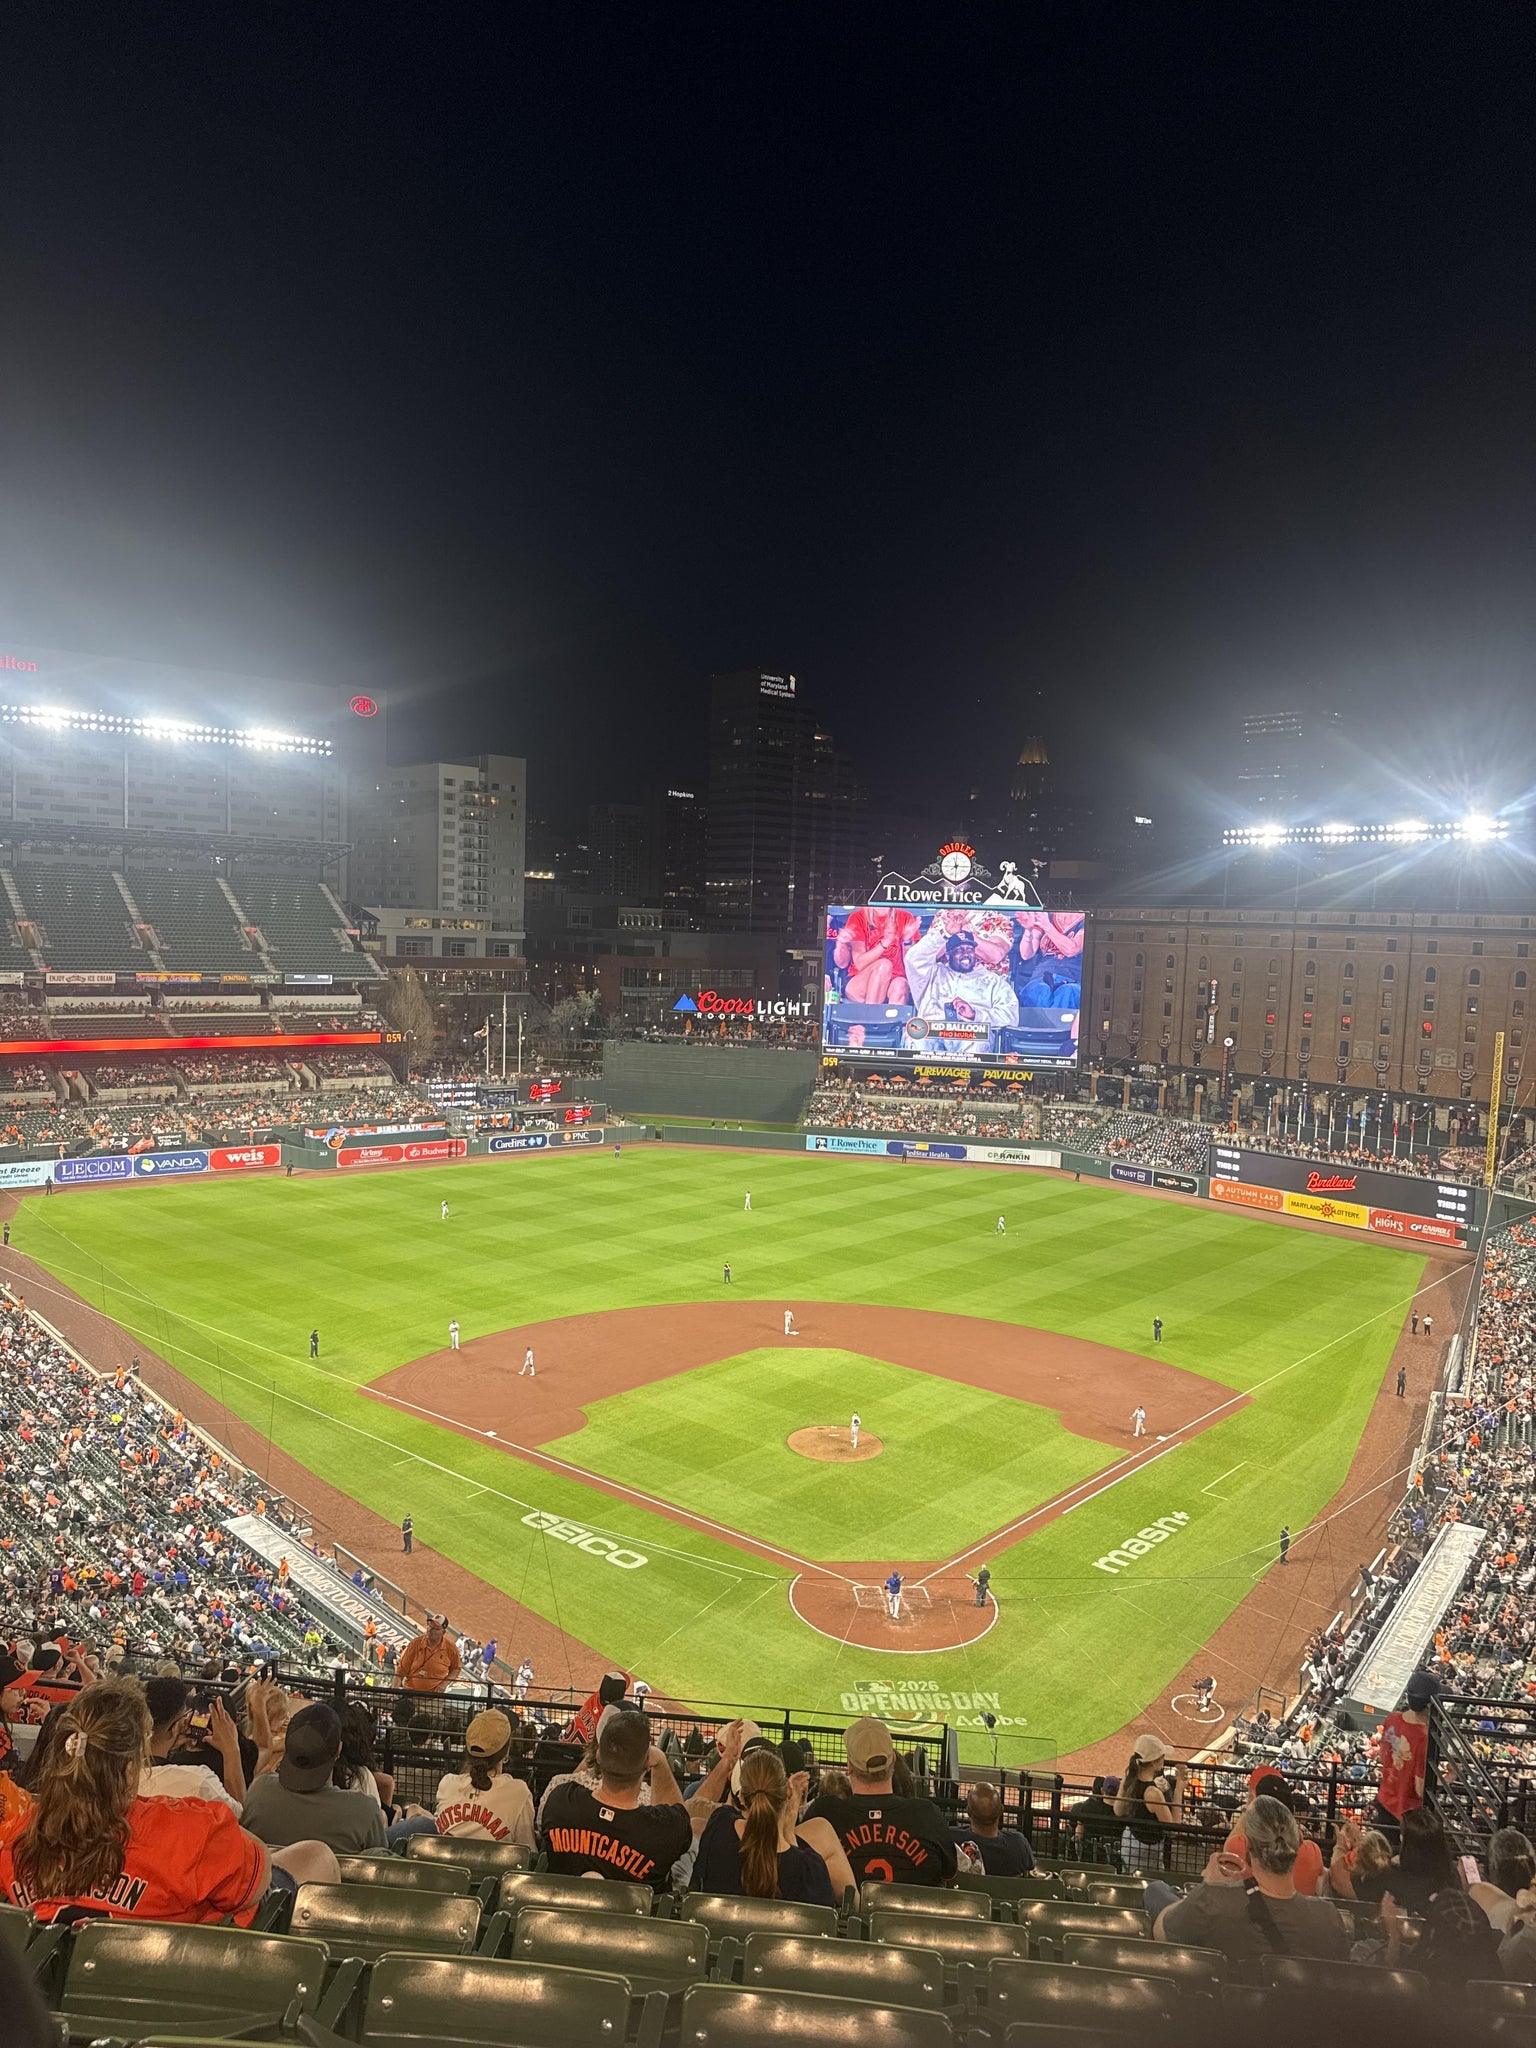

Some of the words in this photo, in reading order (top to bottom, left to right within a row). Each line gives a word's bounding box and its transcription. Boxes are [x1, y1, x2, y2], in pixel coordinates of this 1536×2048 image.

[760, 673, 784, 683] University
[767, 682, 788, 690] Maryland
[760, 688, 778, 696] Medical
[779, 690, 795, 698] System
[939, 842, 976, 858] ORIOLES
[698, 991, 754, 1013] Coors
[757, 1000, 812, 1016] LIGHT
[931, 1023, 945, 1031] KID
[946, 1024, 986, 1032] BALLOON
[914, 1067, 971, 1078] PUREWAGER
[983, 1070, 1034, 1081] PAVILION
[377, 1125, 398, 1134] BIRD
[399, 1123, 422, 1133] BATH
[572, 1132, 589, 1140] PNC
[495, 1137, 528, 1149] CareFirst
[226, 1149, 264, 1163] weis
[422, 1146, 462, 1155] Budweser
[905, 1150, 929, 1158] edStar
[61, 1160, 126, 1176] LECOM
[155, 1157, 202, 1168] VANDA
[1116, 1168, 1137, 1178] TRUIST
[1306, 1171, 1358, 1193] Birdland
[1226, 1186, 1258, 1198] AUTUMN
[1259, 1192, 1279, 1202] LAKE
[1291, 1201, 1320, 1212] MARYLAND
[1375, 1217, 1404, 1232] HIGH'S
[1422, 1224, 1451, 1235] CARROLL
[520, 1511, 648, 1570] GEICO
[1091, 1511, 1191, 1574] masn+
[897, 1680, 939, 1692] 2026
[840, 1692, 952, 1712] OPENING
[951, 1692, 1000, 1710] DAY
[843, 1823, 928, 1867] NDERSON
[549, 1827, 655, 1880] MOUNTCASTLE
